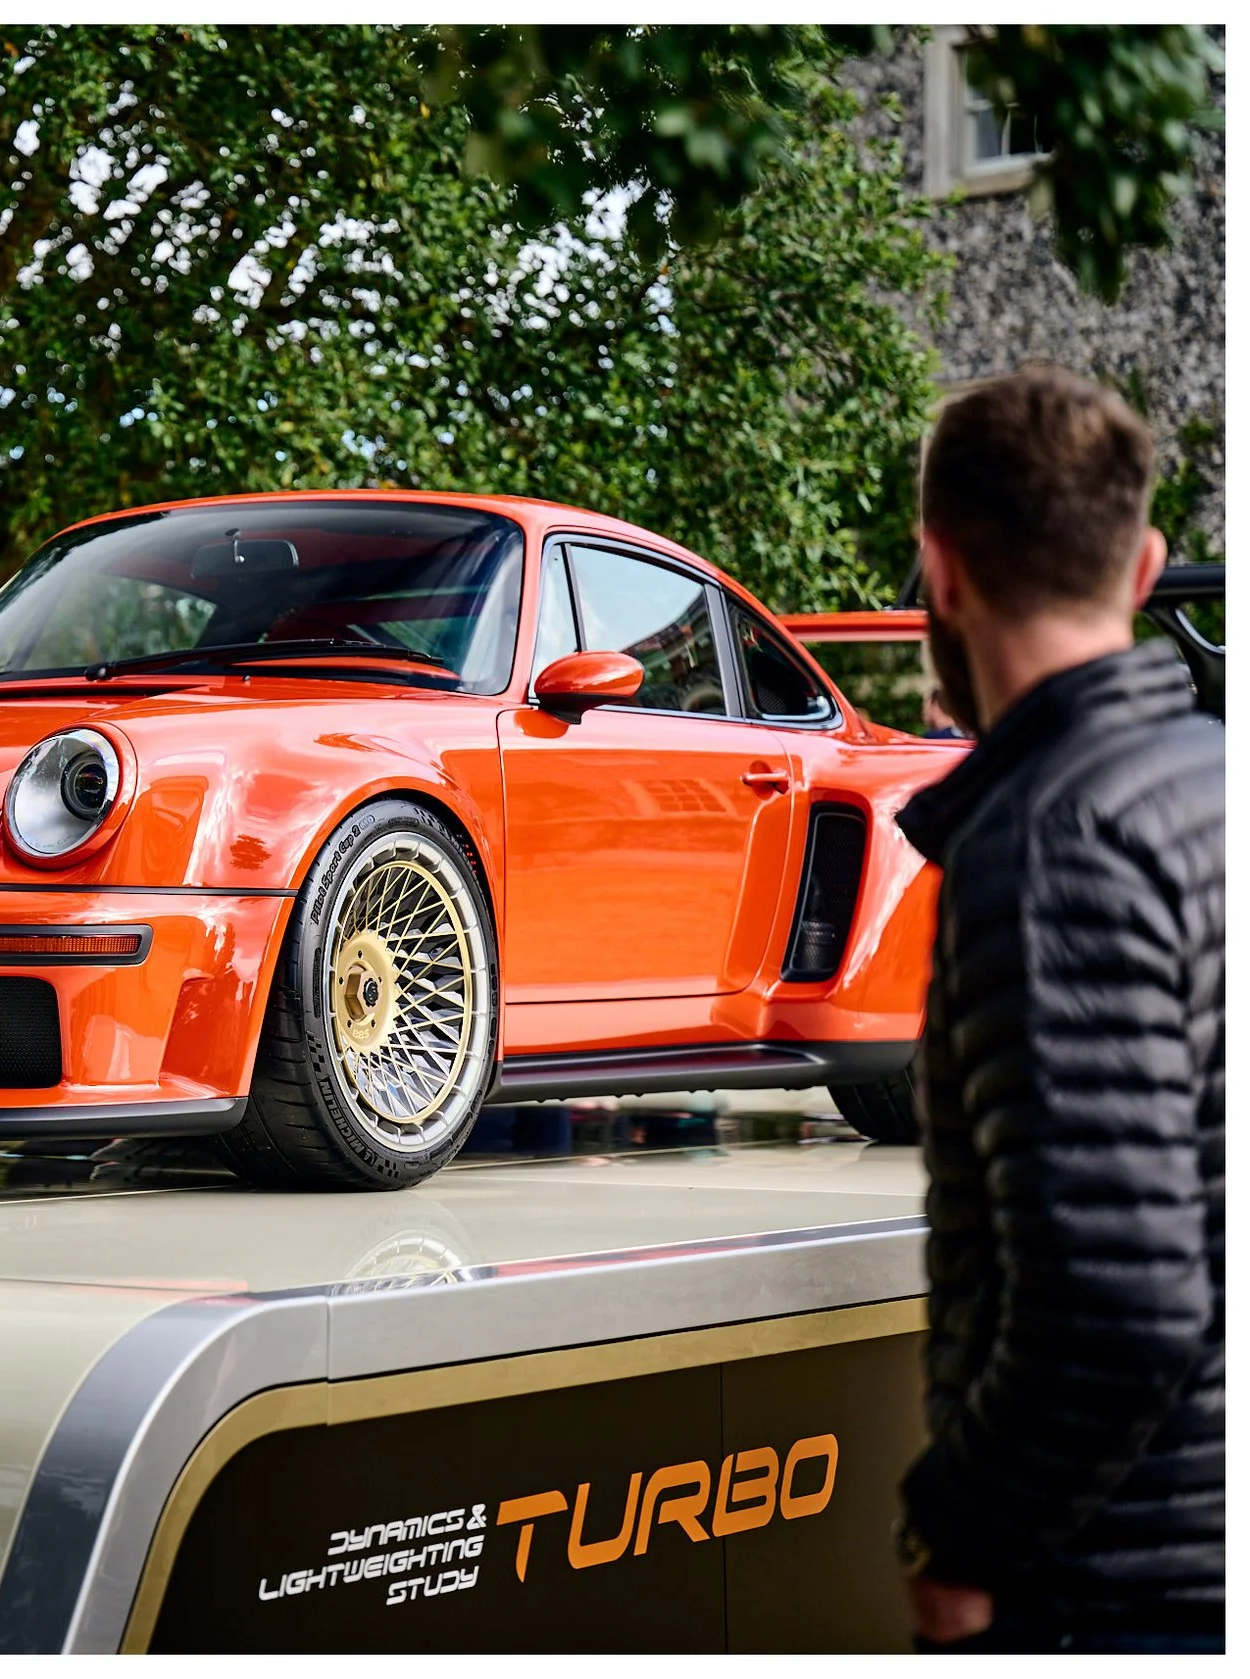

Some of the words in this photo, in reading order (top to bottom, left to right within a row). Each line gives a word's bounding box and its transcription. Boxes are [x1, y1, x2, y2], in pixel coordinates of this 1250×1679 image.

[321, 850, 342, 890] Sport
[338, 835, 355, 854] Cup
[351, 824, 362, 837] 2
[317, 1076, 367, 1154] MICHELIN
[327, 1508, 465, 1556] DYNAMICS
[466, 1503, 487, 1531] &
[496, 1433, 838, 1582] TURBO
[258, 1534, 485, 1601] LIGHTWEIGHTING
[386, 1565, 479, 1606] STUDY
